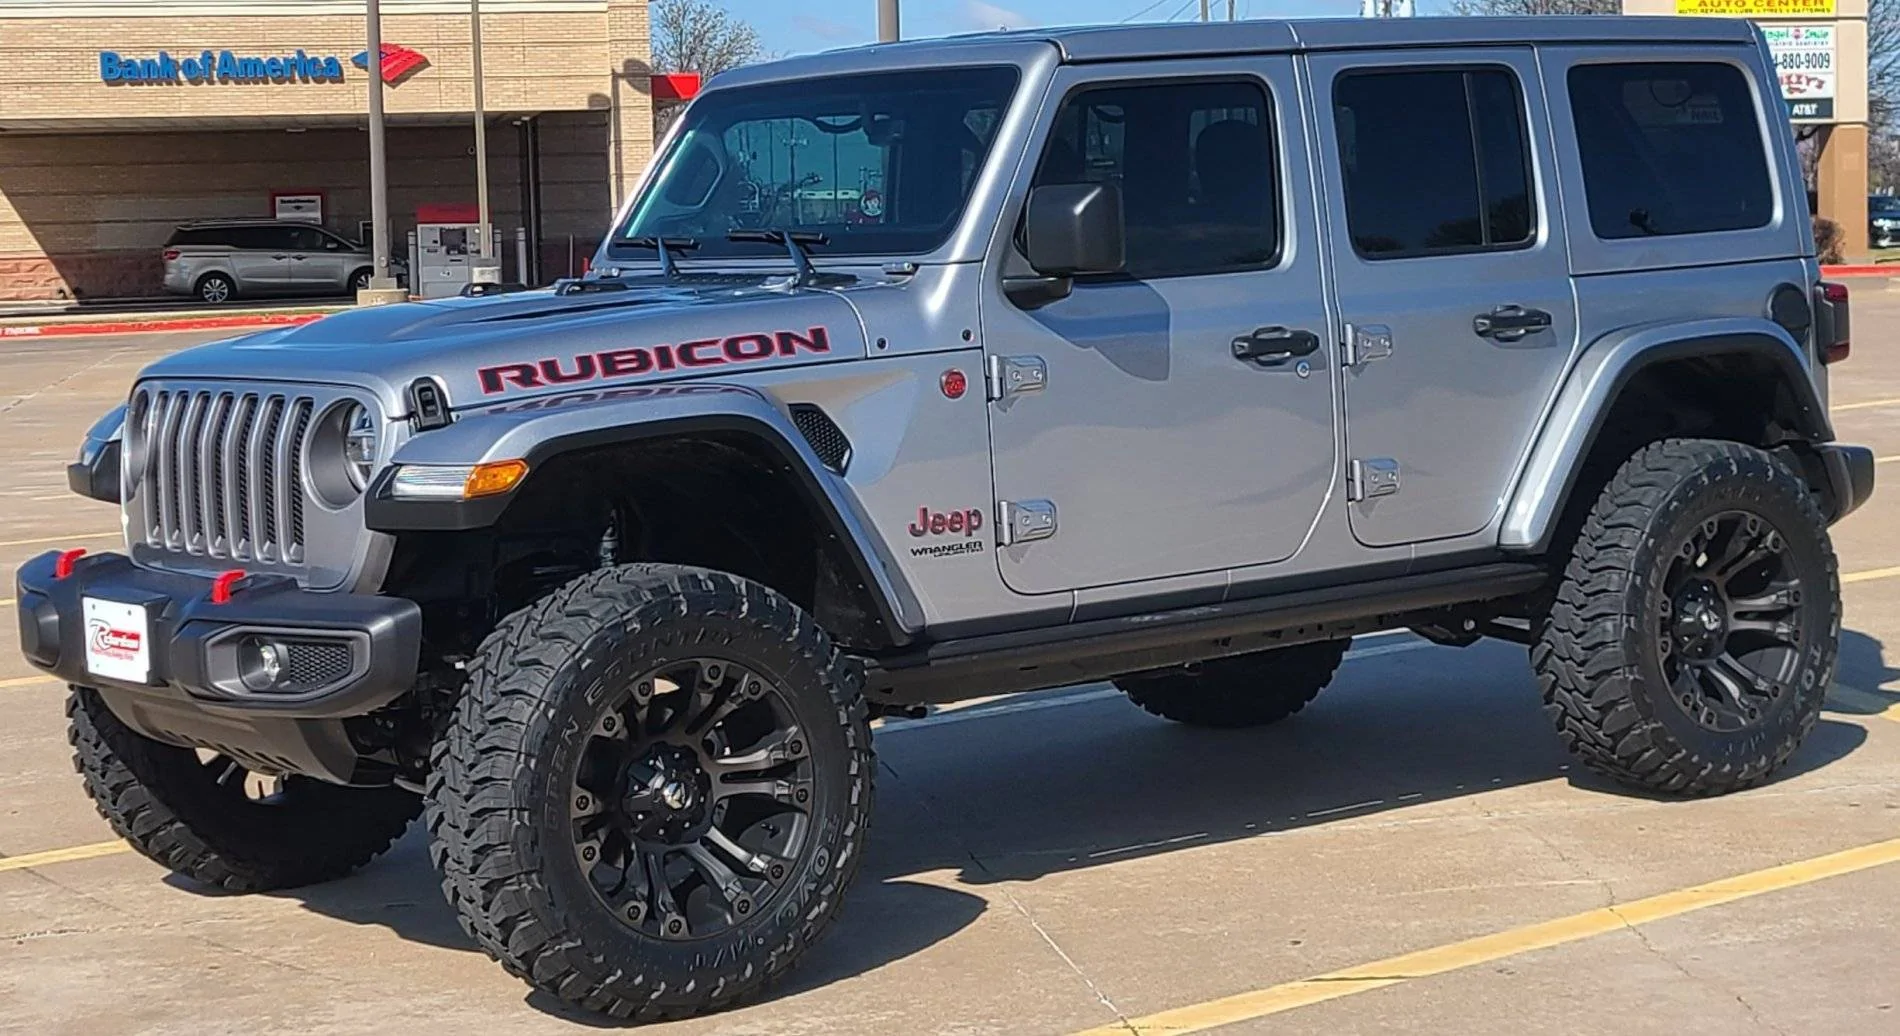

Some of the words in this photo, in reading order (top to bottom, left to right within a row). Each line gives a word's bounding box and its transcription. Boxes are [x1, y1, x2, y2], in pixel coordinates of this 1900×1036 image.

[1698, 0, 1747, 8] AUTO
[1753, 0, 1825, 8] CENTER
[101, 50, 176, 80] Bank
[182, 50, 212, 78] of
[216, 49, 340, 79] America
[1791, 103, 1818, 116] AT&T
[476, 326, 832, 395] RUBICON
[908, 506, 984, 538] Jeep
[910, 540, 983, 556] WRANGLER
